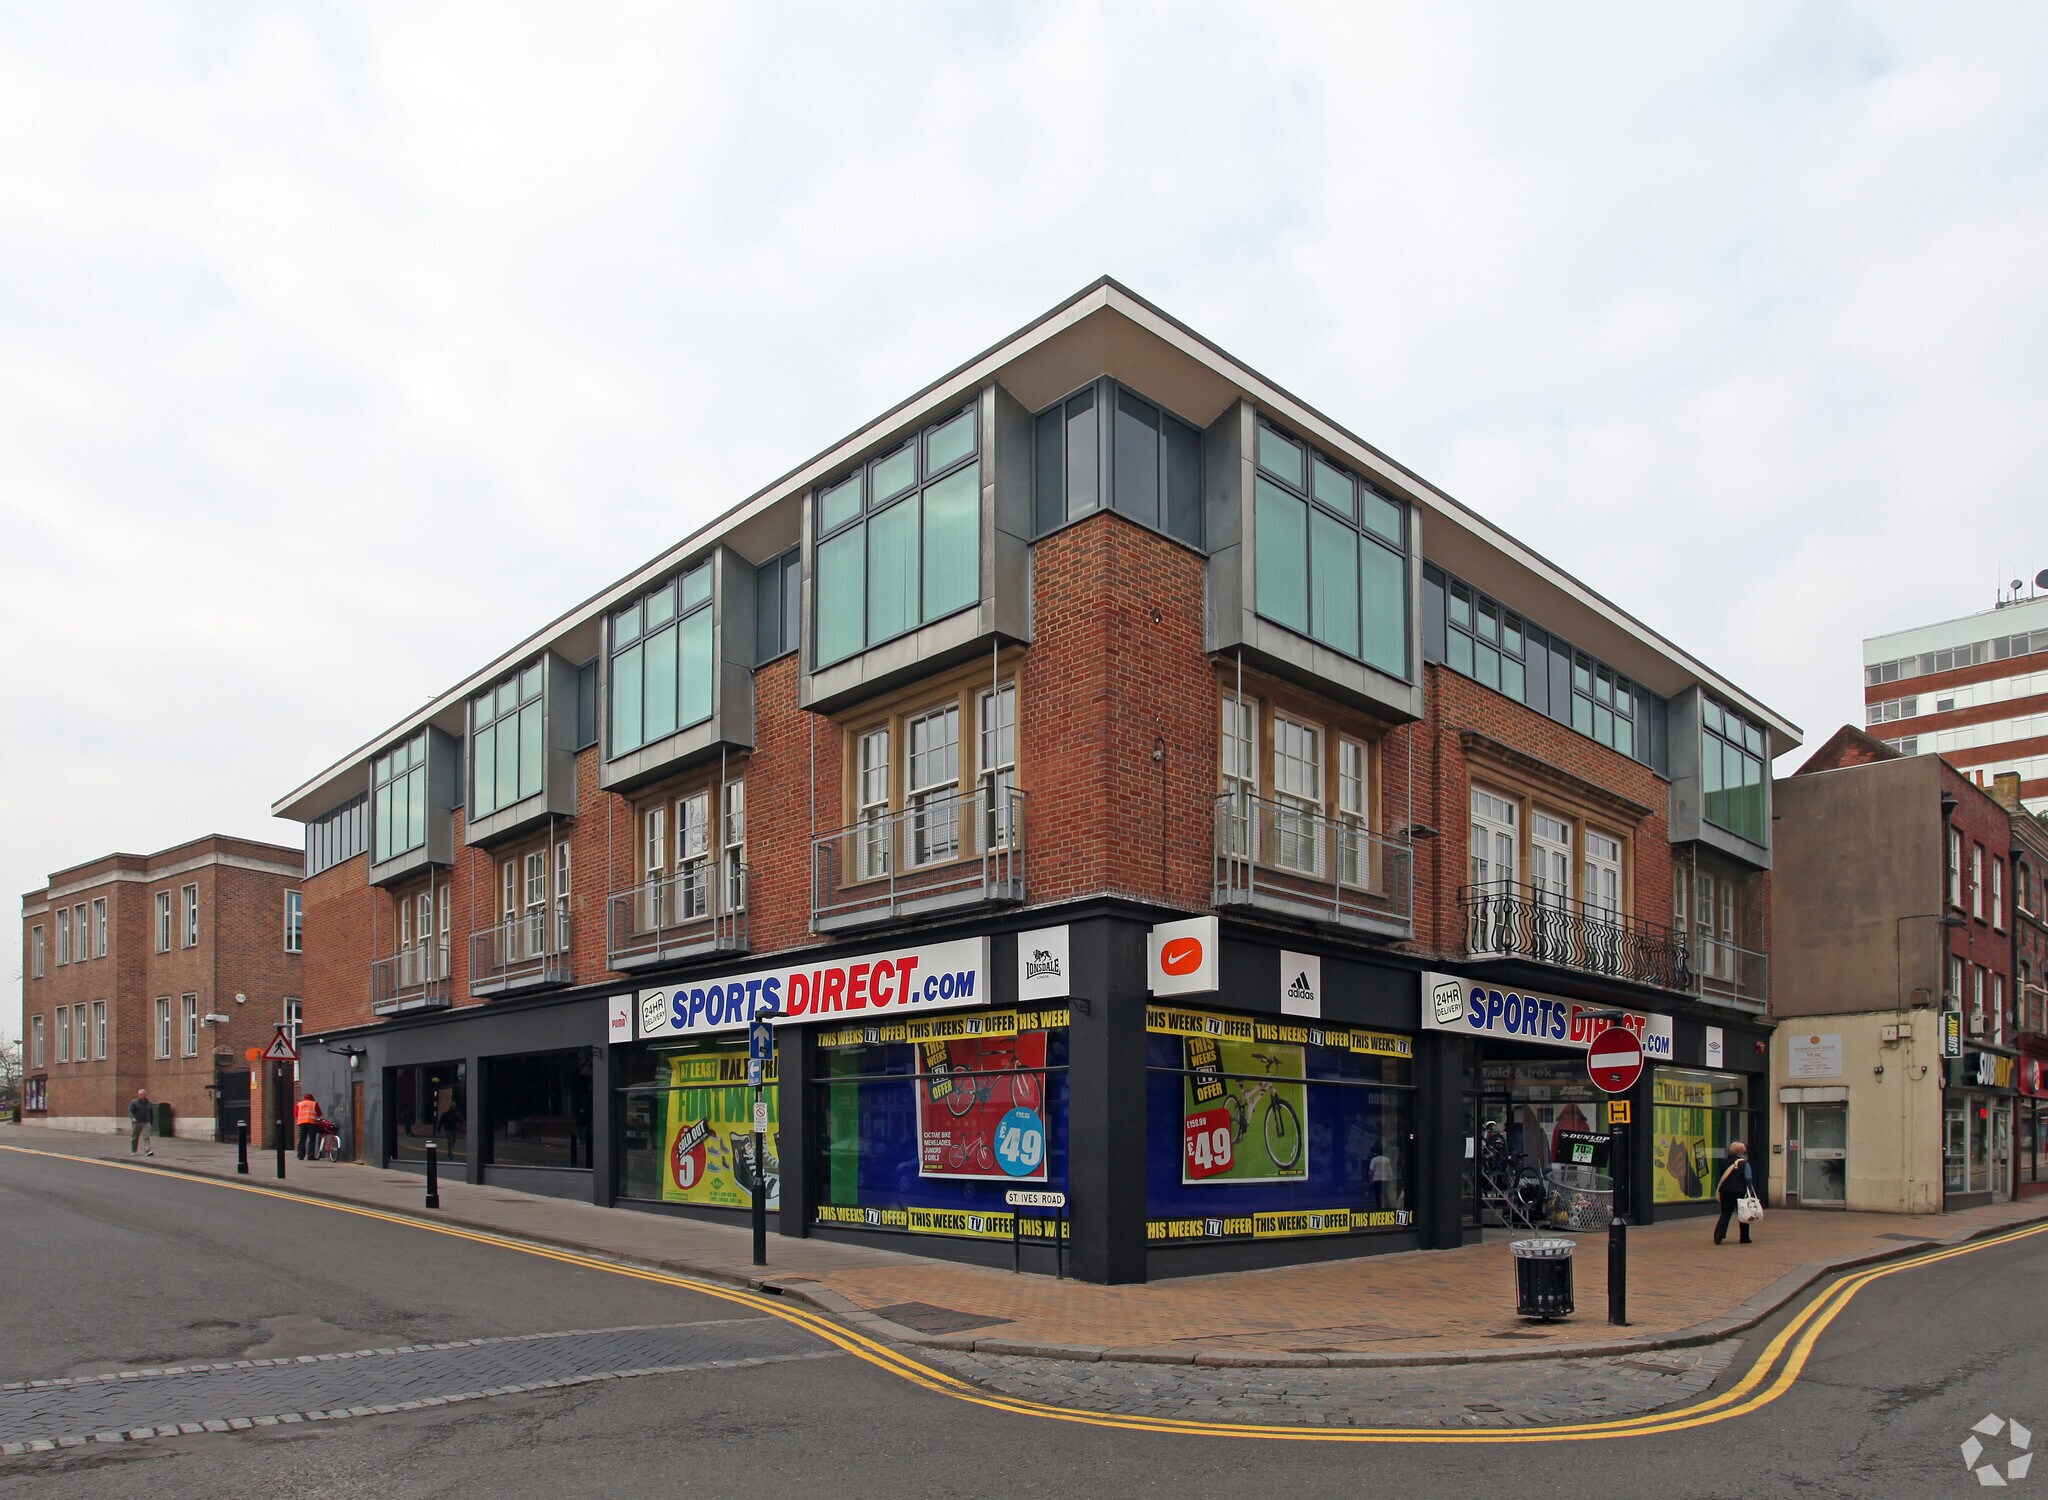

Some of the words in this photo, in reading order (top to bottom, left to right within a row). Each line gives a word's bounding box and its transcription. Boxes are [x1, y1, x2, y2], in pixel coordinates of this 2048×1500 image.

[1026, 958, 1061, 980] LONSDALE
[1287, 988, 1315, 1001] adidas
[1436, 989, 1460, 1006] 24HR
[644, 998, 665, 1019] 24HR
[1436, 1004, 1462, 1017] DELIVERY
[908, 1022, 930, 1039] THIS
[931, 1019, 964, 1037] WEEKS
[984, 1014, 1015, 1032] OFFER
[1016, 1012, 1039, 1030] THIS
[1168, 1013, 1203, 1032] WEEKS
[1224, 1020, 1252, 1038] OFFER
[817, 1032, 838, 1048] THIS
[837, 1028, 864, 1046] WEEKS
[879, 1025, 906, 1042] OFFER
[1255, 1022, 1278, 1041] THIS
[1278, 1026, 1308, 1043] WEEKS
[1325, 1032, 1349, 1047] OFFER
[1351, 1033, 1369, 1049] THIS
[1370, 1035, 1396, 1052] WEEKS
[1947, 1014, 1960, 1055] SUBWAY
[924, 1040, 945, 1057] THIS
[1188, 1038, 1215, 1056] THIS
[926, 1049, 947, 1068] WEEKS
[1191, 1050, 1217, 1067] WEEKS
[680, 1062, 689, 1079] AT
[690, 1060, 717, 1079] LEAST
[1976, 1051, 2015, 1089] SUBWAY
[932, 1080, 953, 1100] OFFER
[1196, 1082, 1223, 1102] OFFER
[678, 1132, 694, 1153] SOLD
[691, 1120, 706, 1140] OUT
[1569, 1133, 1611, 1143] DUNLOP
[1187, 1128, 1232, 1169] £49
[1021, 1194, 1038, 1203] IVES
[1041, 1195, 1062, 1204] ROAD
[818, 1205, 836, 1221] THIS
[836, 1206, 865, 1223] WEEKS
[881, 1210, 907, 1226] OFFER
[910, 1211, 932, 1227] THIS
[933, 1213, 966, 1230] WEEKS
[1255, 1217, 1276, 1233] THIS
[1277, 1215, 1308, 1232] WEEKS
[1324, 1213, 1348, 1228] OFFER
[1351, 1212, 1368, 1228] THIS
[1369, 1210, 1395, 1227] WEEKS
[1019, 1218, 1043, 1237] THIS
[1168, 1219, 1204, 1238] WEEKS
[1223, 1217, 1252, 1236] OFFER
